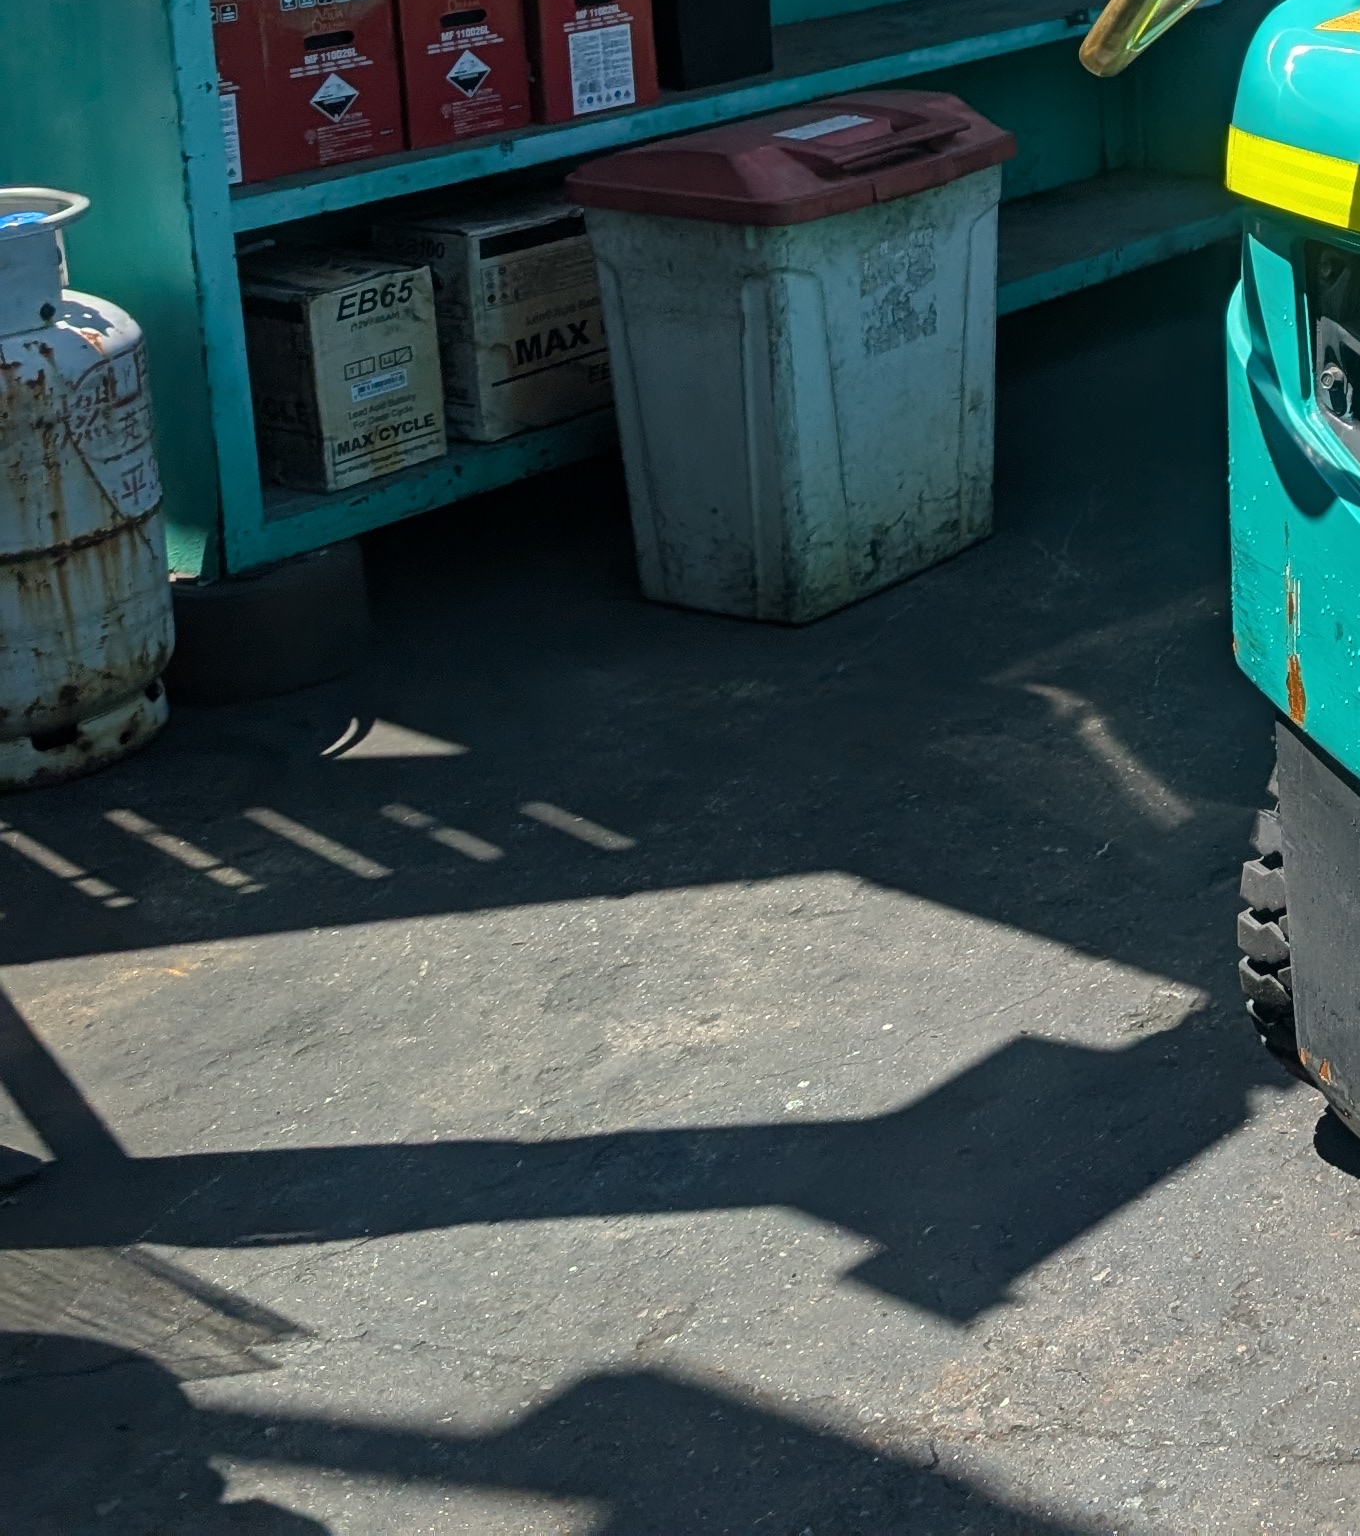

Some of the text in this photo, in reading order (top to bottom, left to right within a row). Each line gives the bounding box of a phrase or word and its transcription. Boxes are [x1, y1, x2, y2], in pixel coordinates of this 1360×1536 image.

[336, 277, 415, 322] EB65
[515, 320, 590, 366] MAX
[337, 413, 436, 456] MAX CYCLE
